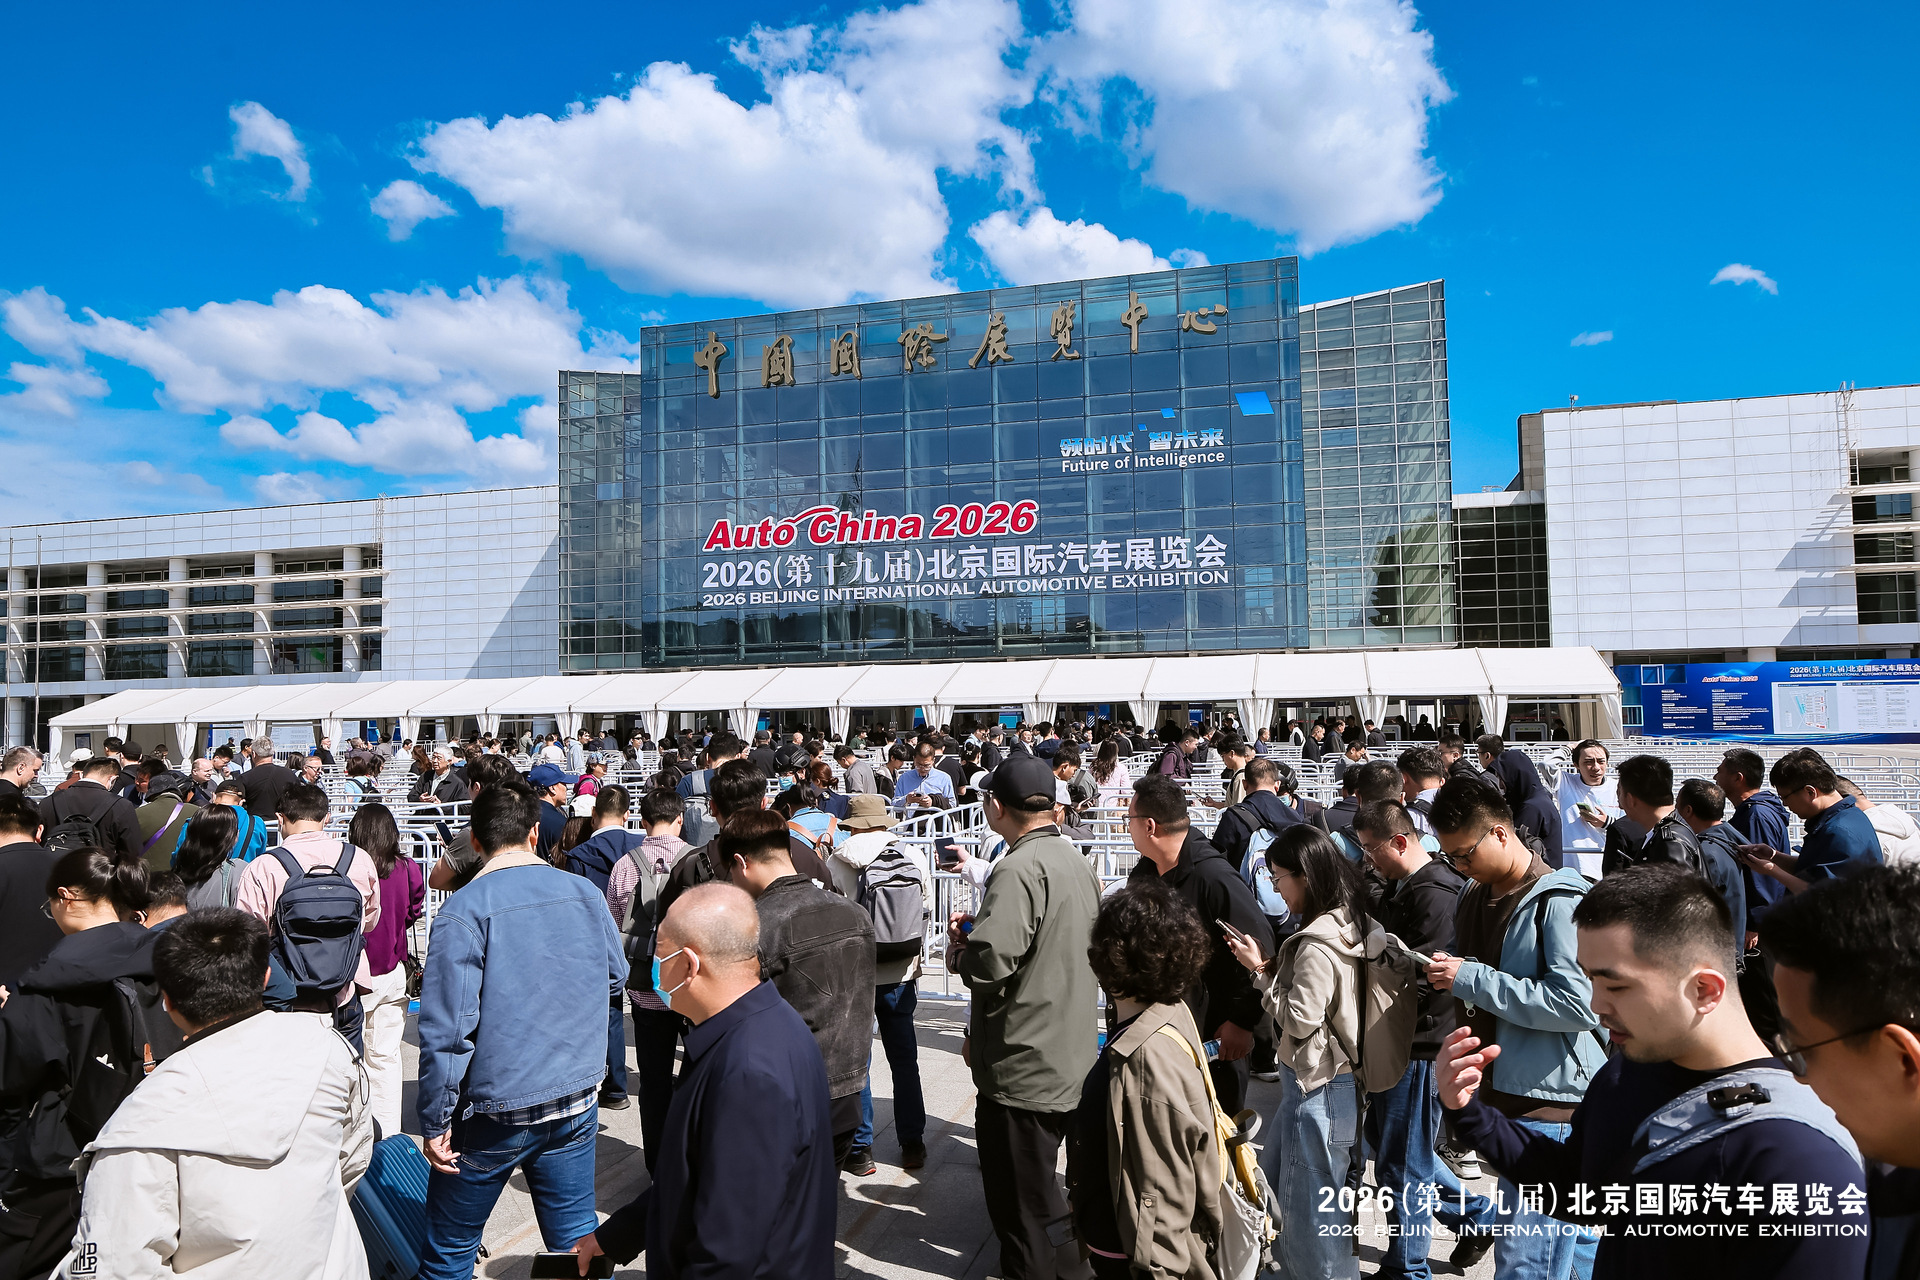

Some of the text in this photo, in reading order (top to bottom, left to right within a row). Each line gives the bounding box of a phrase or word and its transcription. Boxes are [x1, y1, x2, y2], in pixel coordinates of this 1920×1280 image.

[1060, 427, 1224, 457] 领时代 智未来
[1062, 452, 1225, 473] Future of Intelligence
[703, 499, 1039, 552] Auto China 2026
[702, 534, 1227, 588] 2026(第十九届)北京国际汽车展览会
[702, 570, 1229, 607] 2026 BEIJING INTERNATIONAL AUTOMOTIVE EXHIBITION
